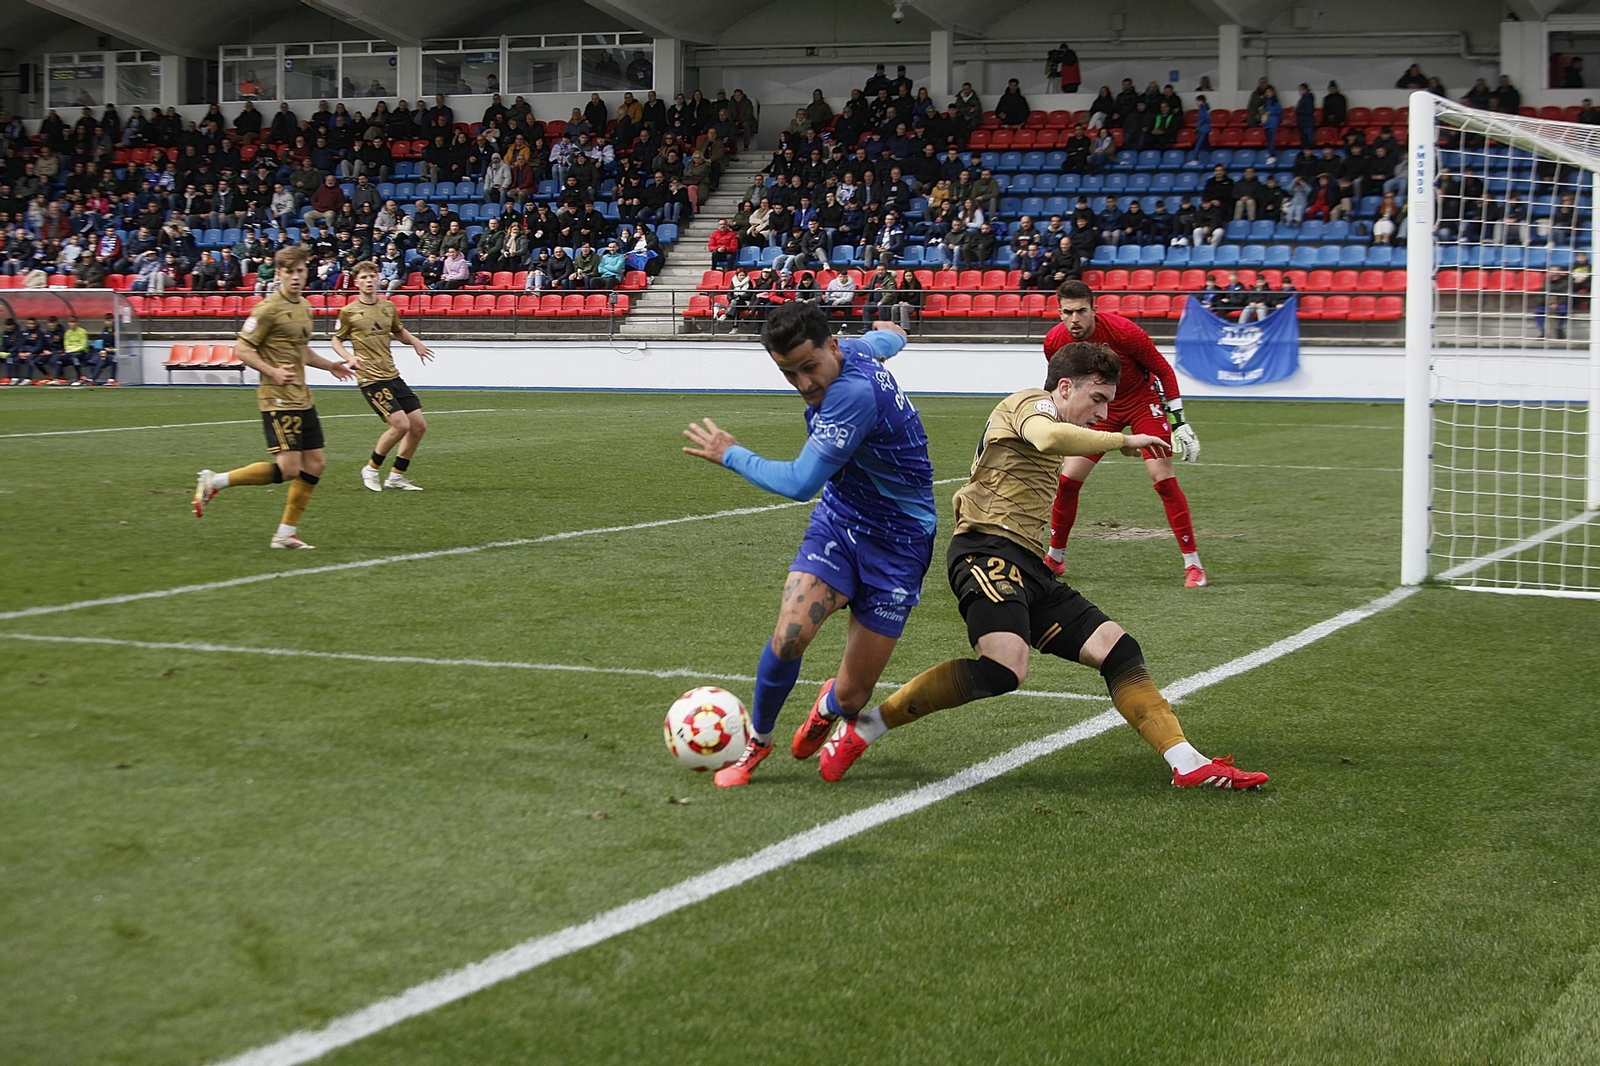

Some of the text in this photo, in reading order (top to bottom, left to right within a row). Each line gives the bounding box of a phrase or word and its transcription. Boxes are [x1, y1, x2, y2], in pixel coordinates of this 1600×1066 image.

[1417, 152, 1425, 195] MONDO
[374, 387, 393, 405] 28
[280, 415, 302, 435] 22
[986, 556, 1025, 589] 24
